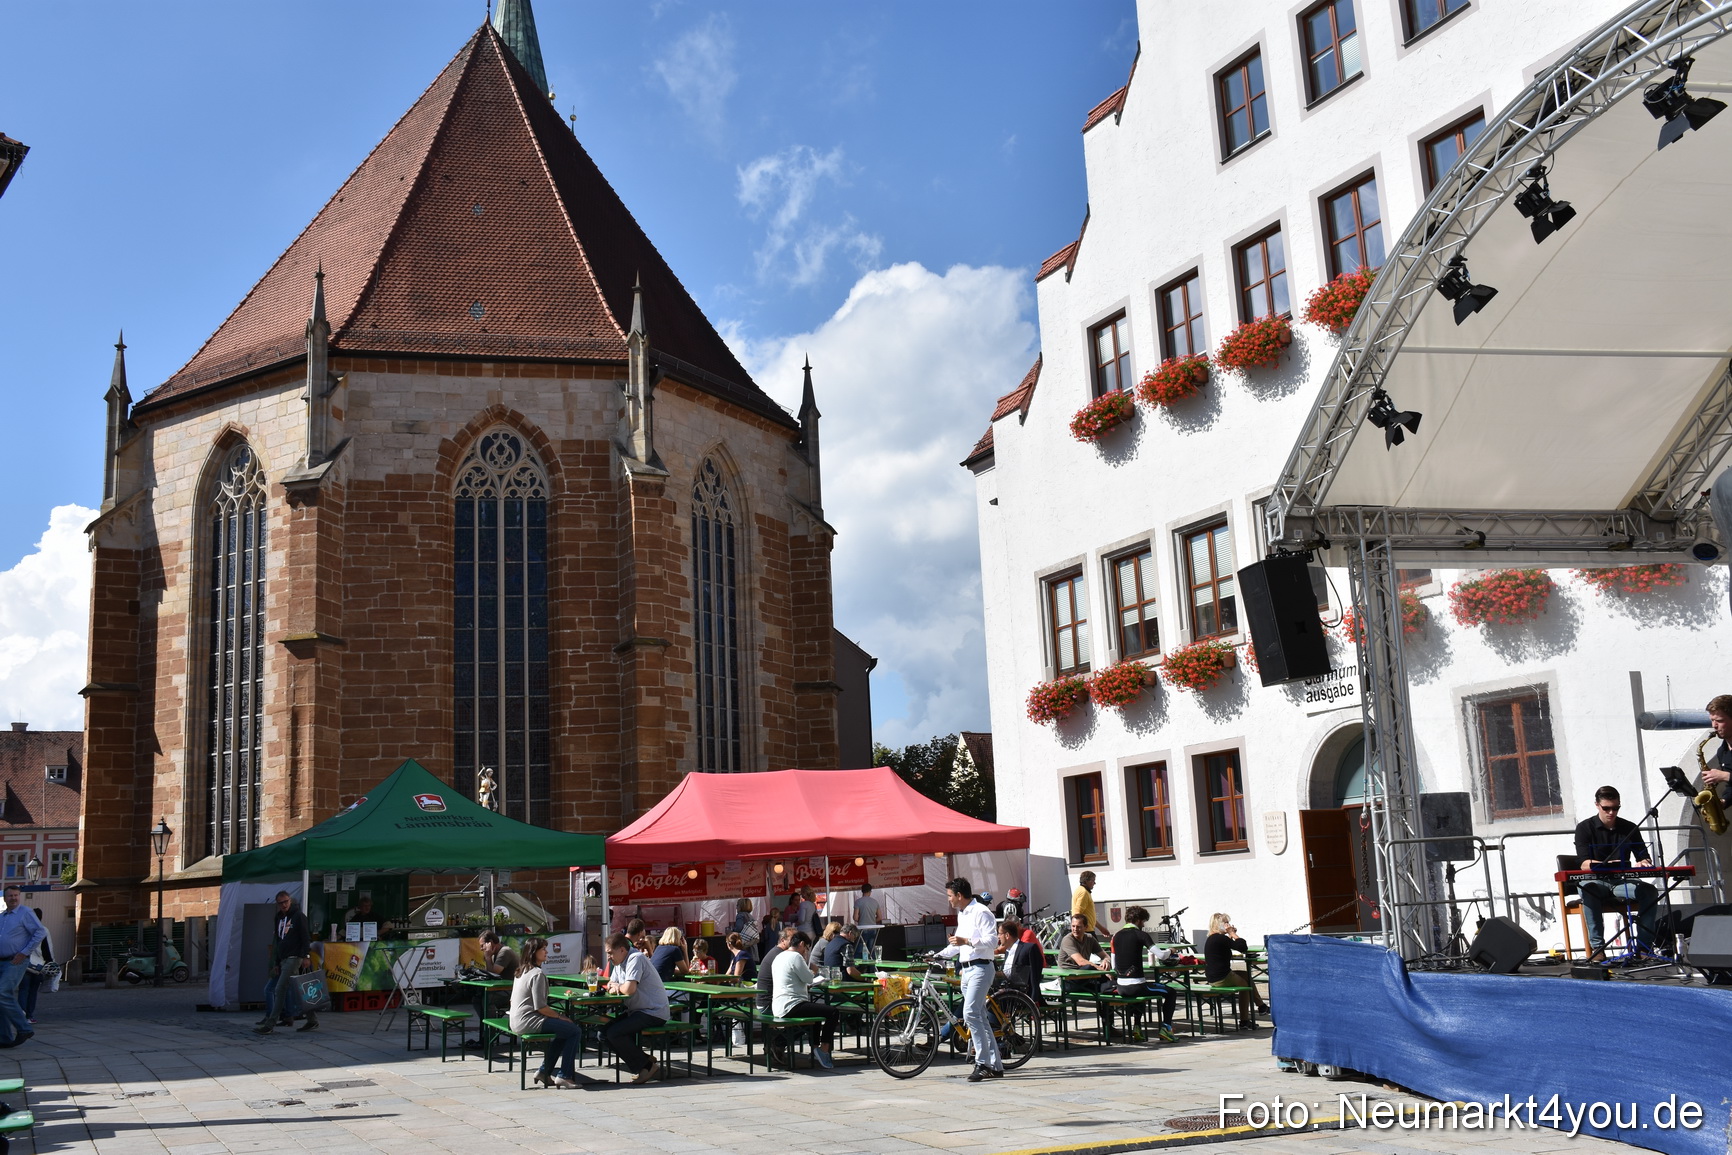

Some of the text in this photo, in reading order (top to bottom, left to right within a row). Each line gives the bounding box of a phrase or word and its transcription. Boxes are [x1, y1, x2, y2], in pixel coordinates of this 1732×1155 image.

[1306, 682, 1354, 703] ausgabe
[404, 814, 475, 822] Neumarkter
[394, 820, 494, 829] Lammsbräu
